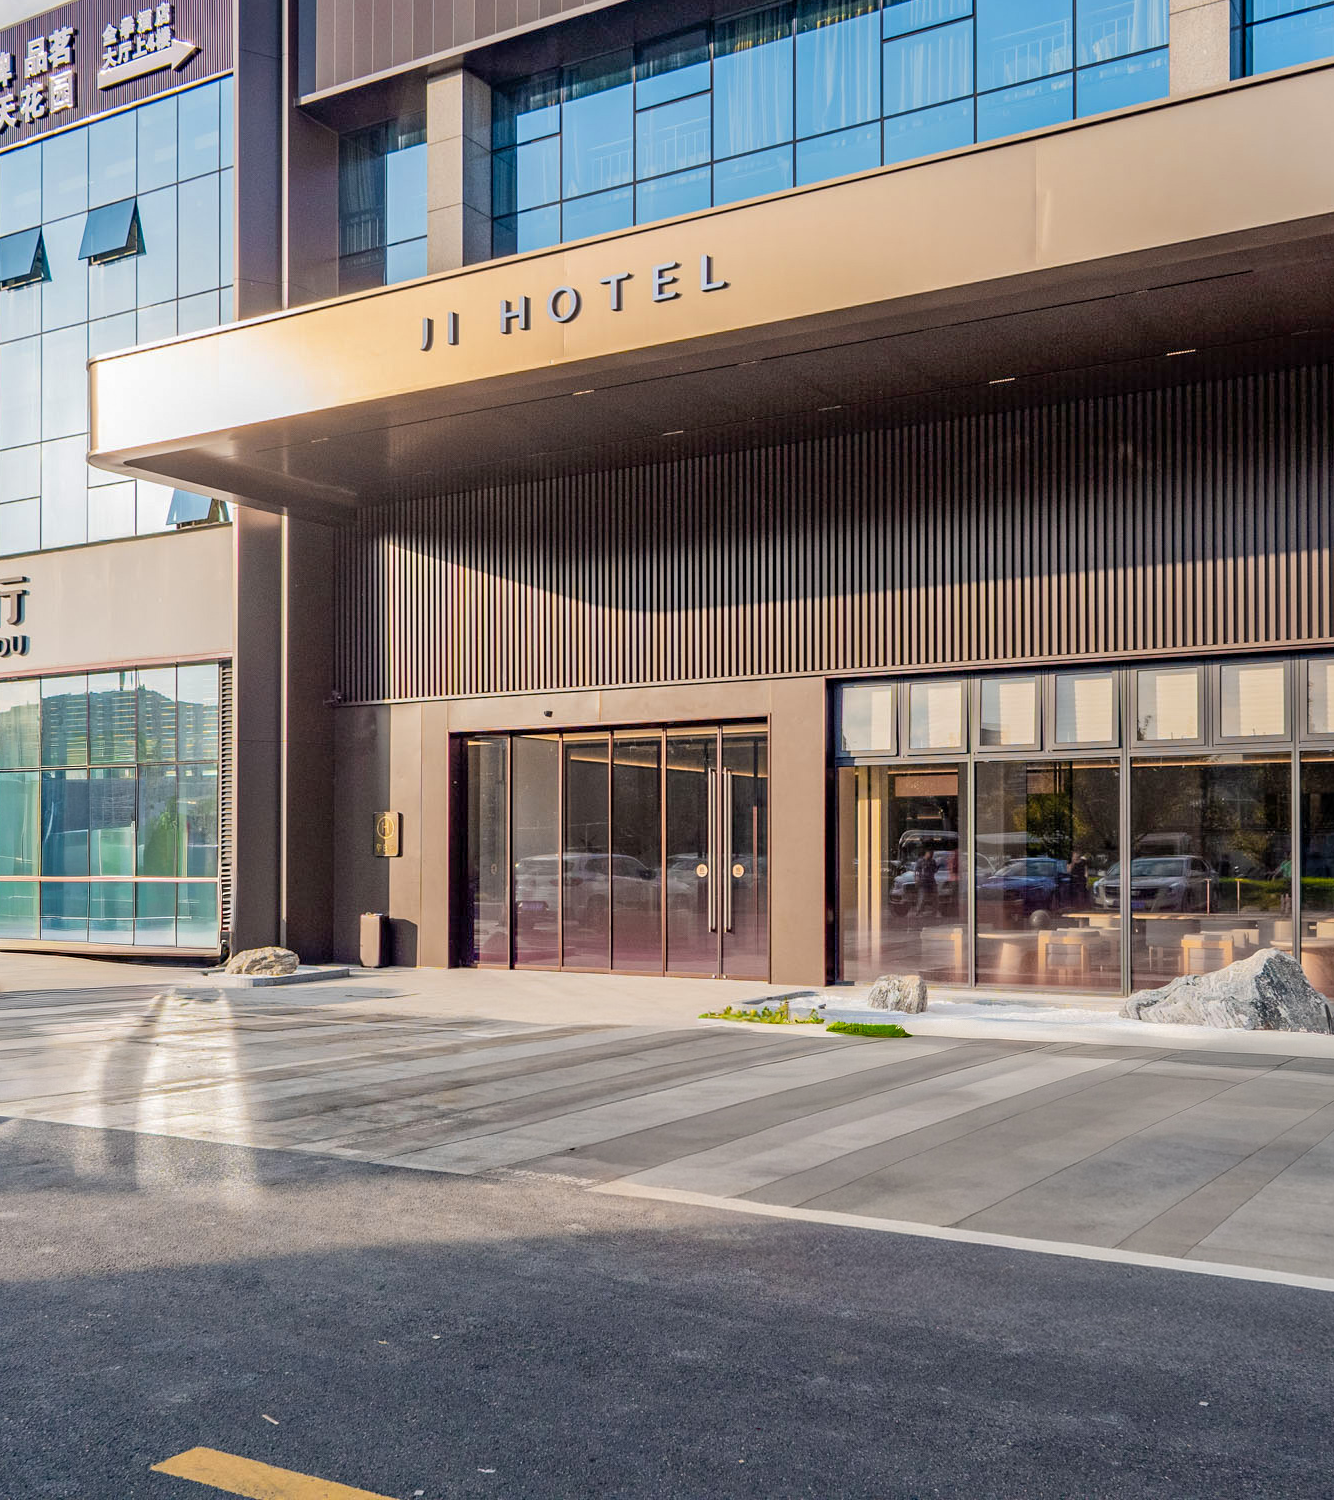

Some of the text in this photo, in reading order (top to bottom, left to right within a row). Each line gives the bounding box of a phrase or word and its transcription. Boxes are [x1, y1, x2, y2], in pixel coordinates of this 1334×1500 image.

[24, 25, 76, 80] 品茗
[420, 253, 730, 352] JI HOTEL
